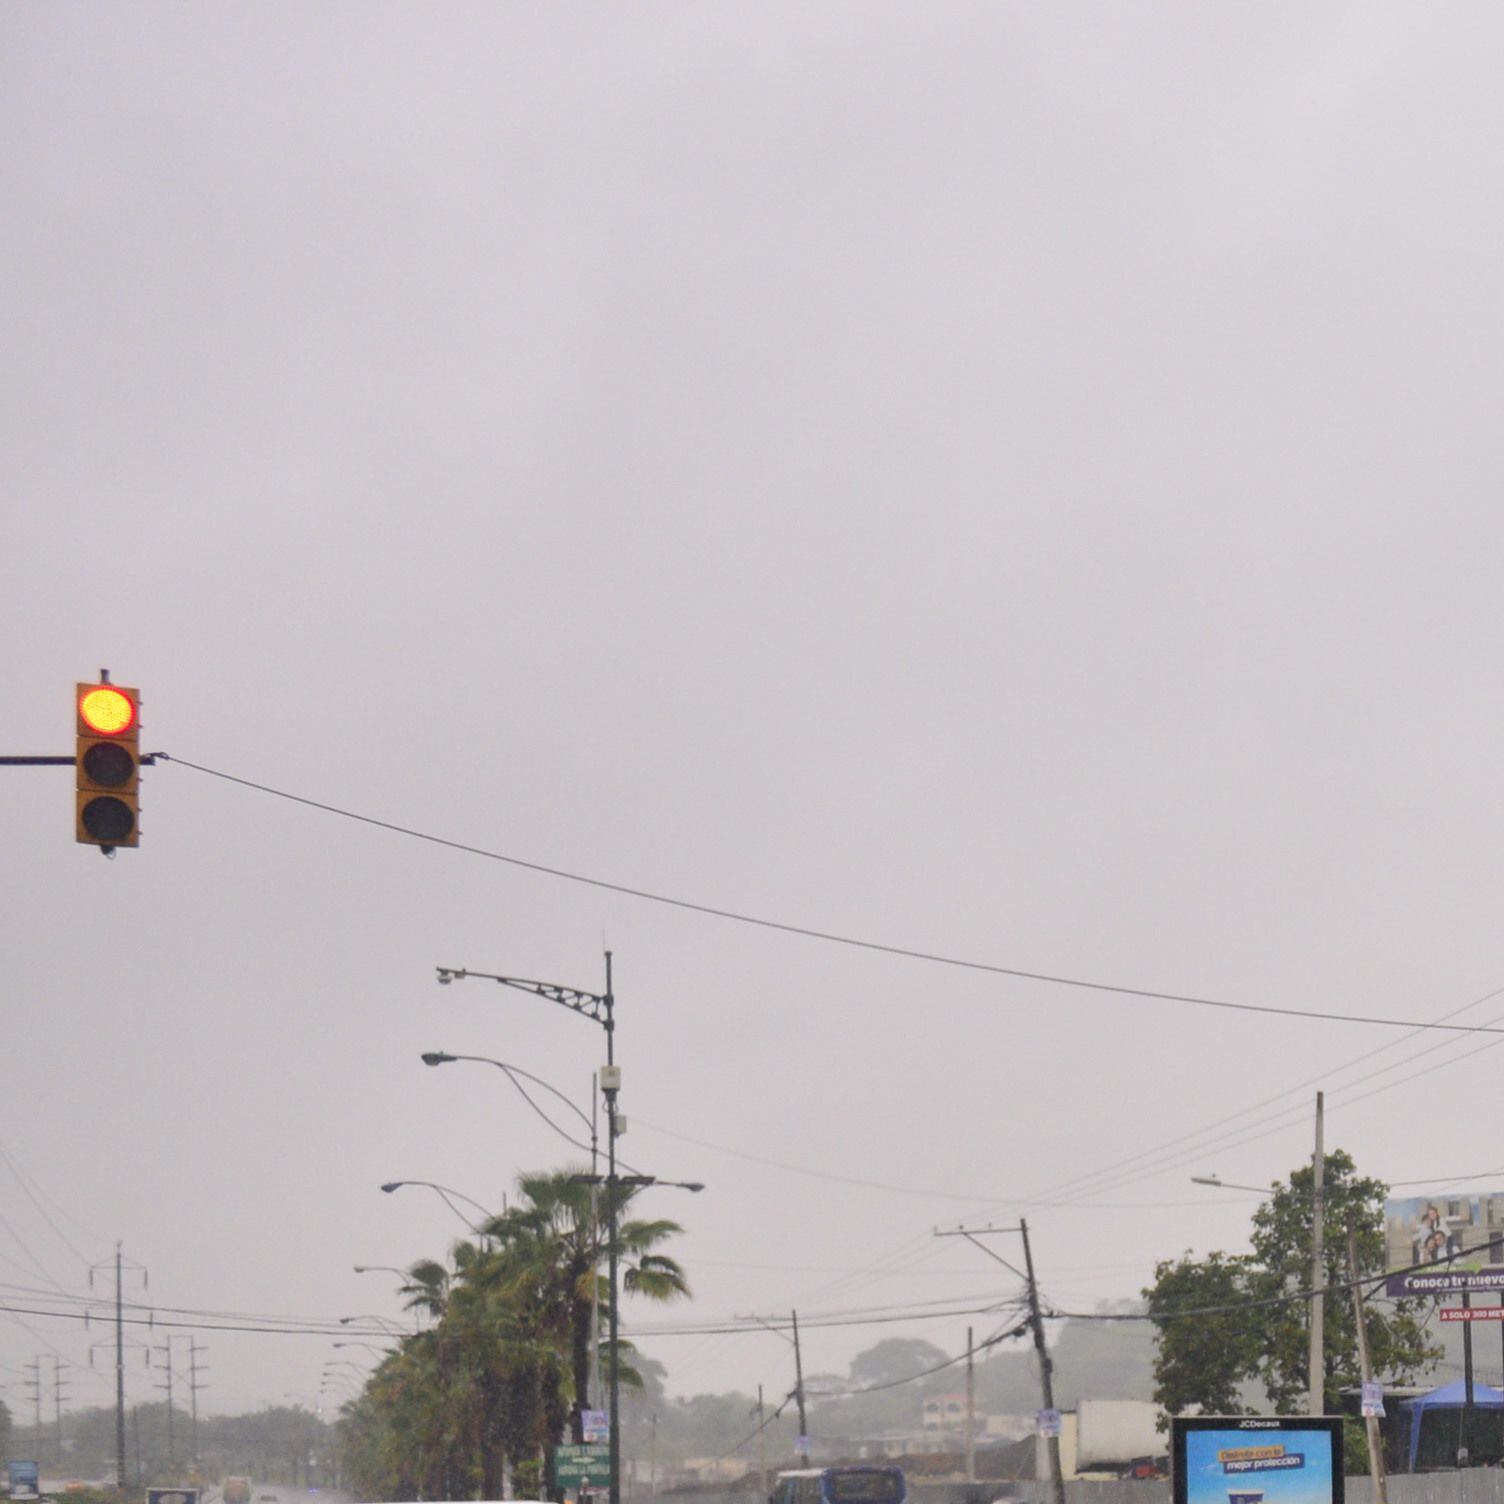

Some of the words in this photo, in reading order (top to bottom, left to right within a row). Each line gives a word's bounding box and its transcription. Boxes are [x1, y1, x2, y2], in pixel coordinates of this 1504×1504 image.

[1450, 1311, 1471, 1319] SOLO
[1239, 1420, 1280, 1429] JCDecaux
[1226, 1461, 1252, 1471] mejor
[1253, 1456, 1300, 1470] protección
